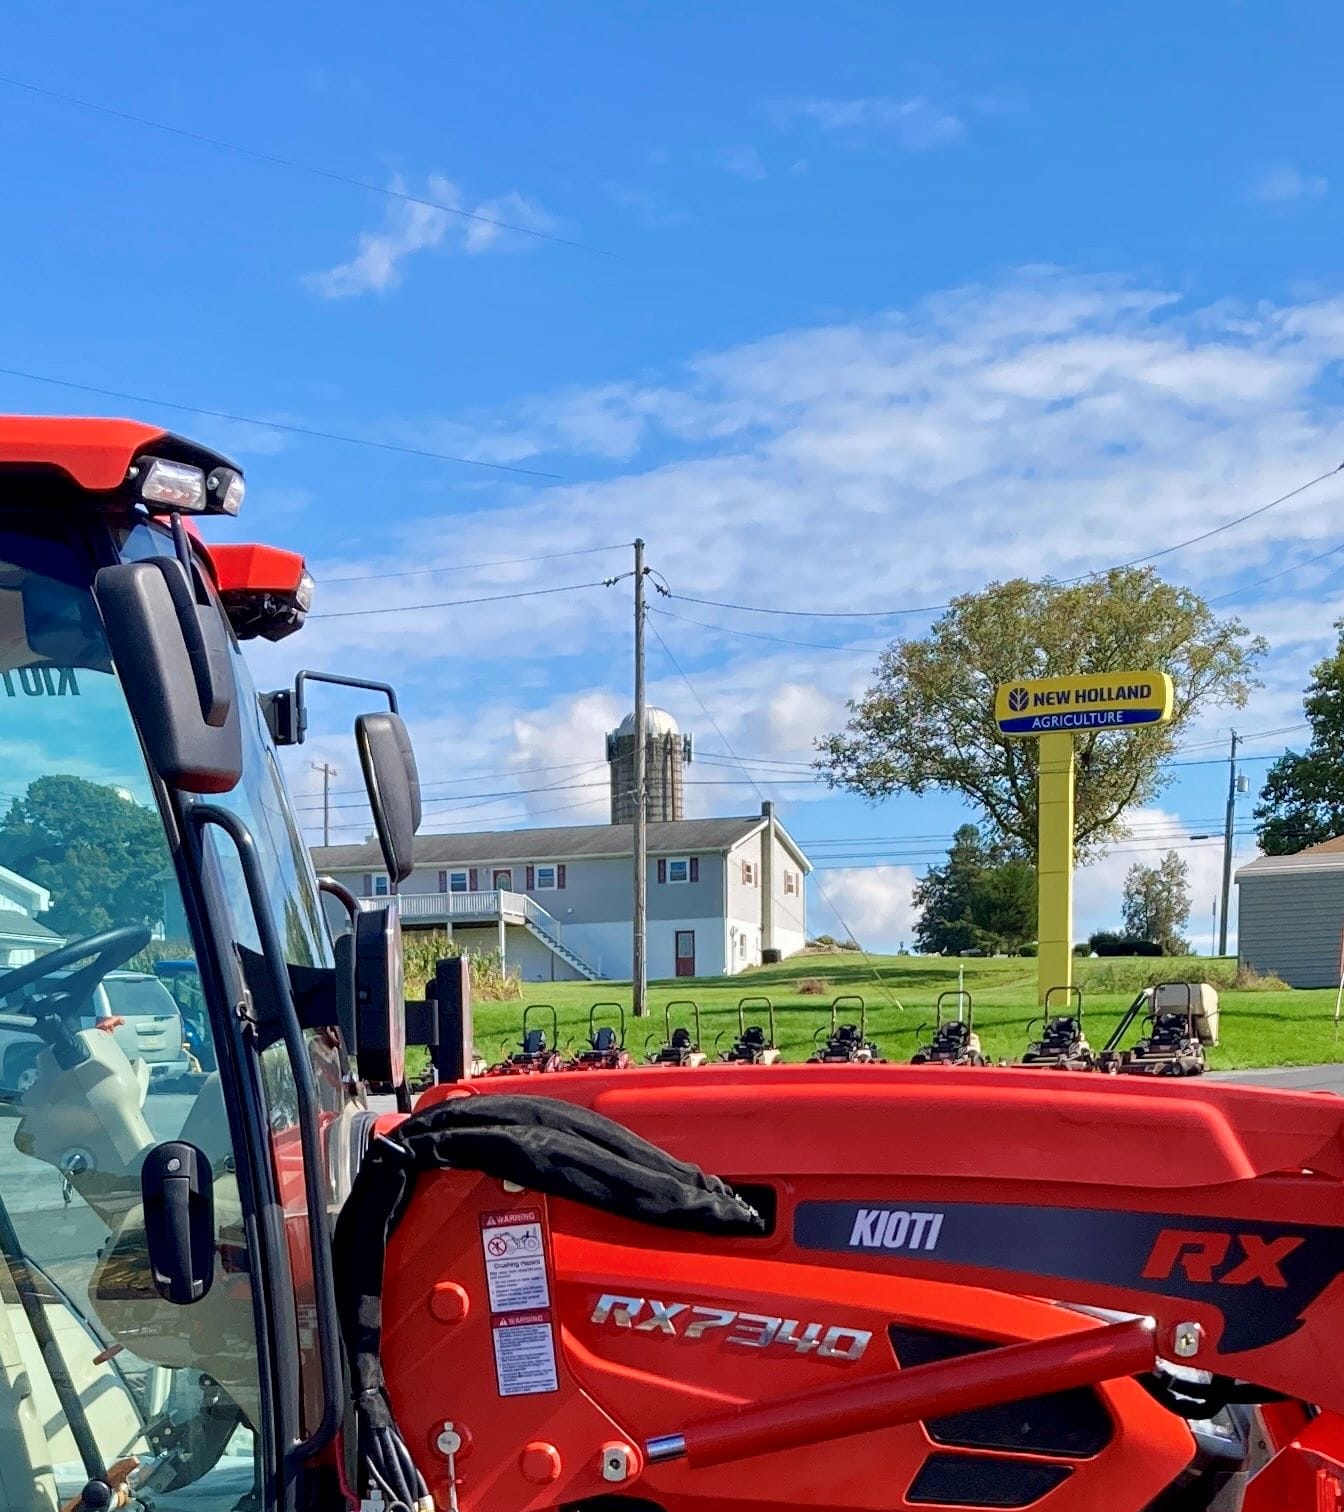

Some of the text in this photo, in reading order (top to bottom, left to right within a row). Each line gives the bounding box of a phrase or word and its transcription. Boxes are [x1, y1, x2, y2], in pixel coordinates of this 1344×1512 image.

[1033, 684, 1152, 707] NEW HOLLAND
[1031, 711, 1124, 729] AGRICULTURE
[496, 1212, 536, 1224] WARNING
[849, 1209, 945, 1250] KIOTI
[1140, 1229, 1306, 1288] RX
[590, 1294, 873, 1361] RX7340
